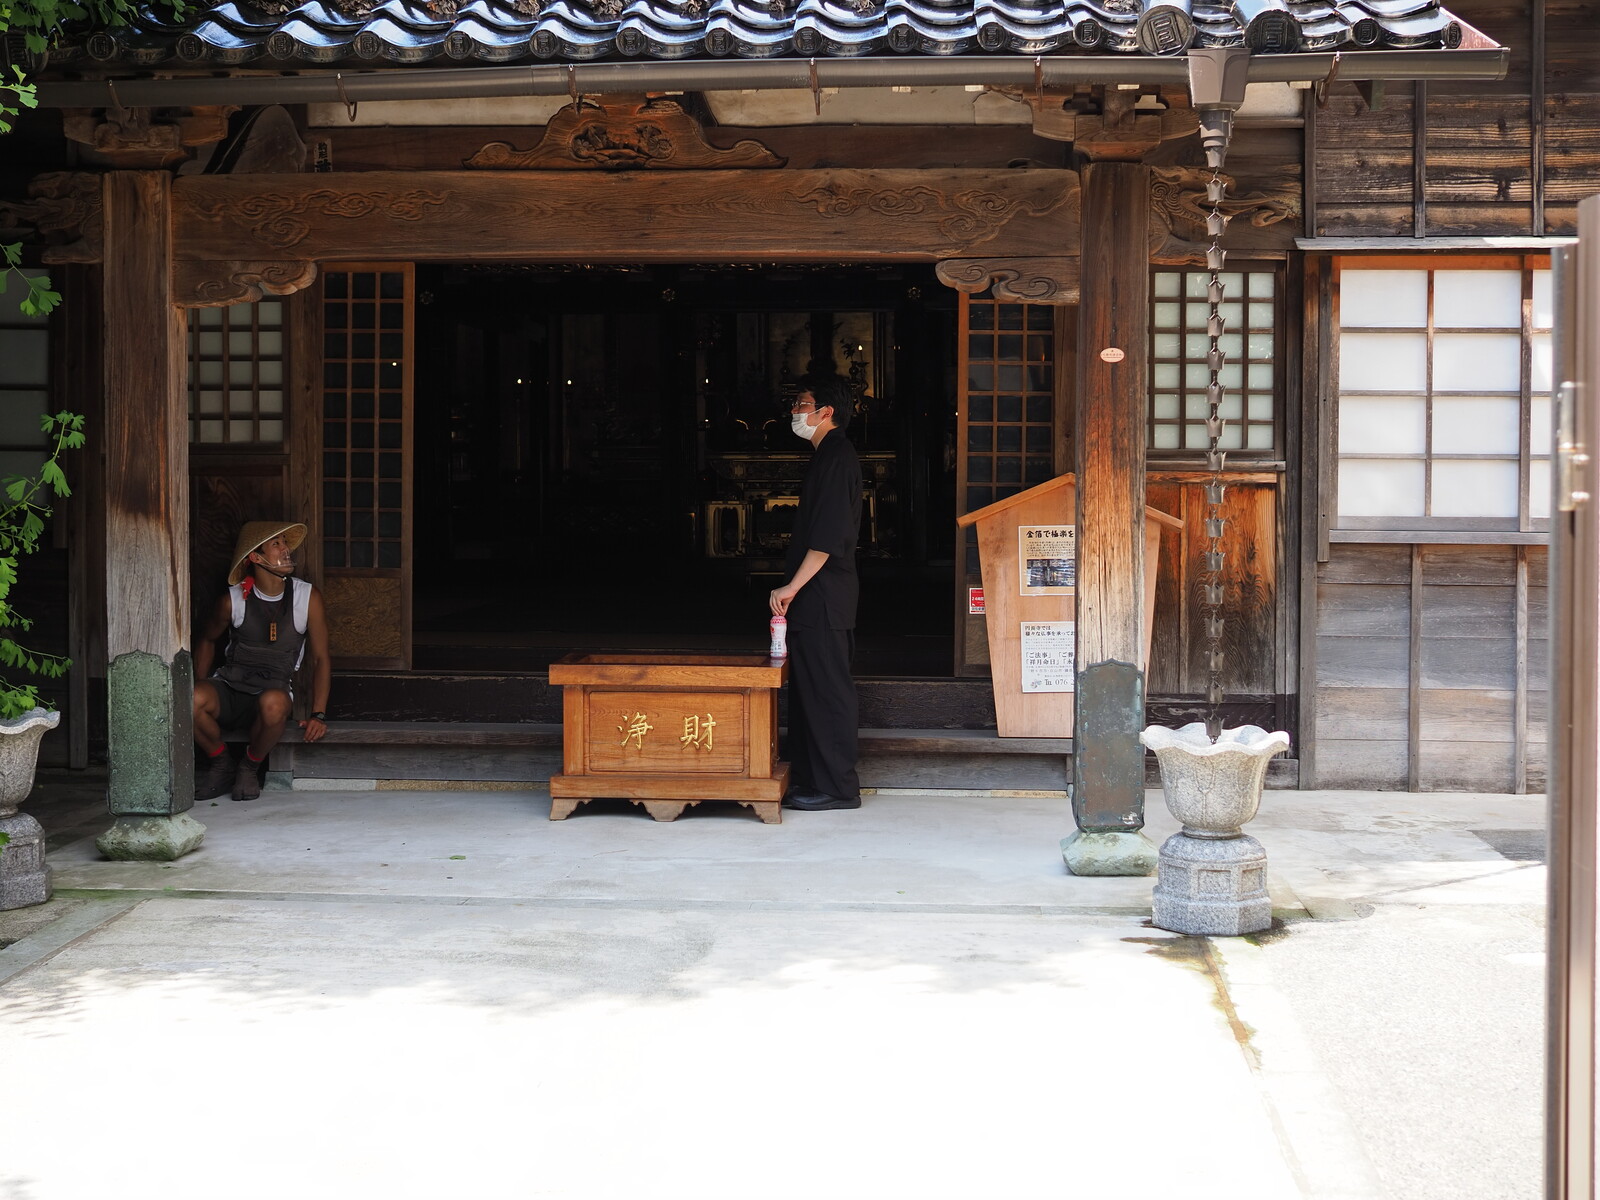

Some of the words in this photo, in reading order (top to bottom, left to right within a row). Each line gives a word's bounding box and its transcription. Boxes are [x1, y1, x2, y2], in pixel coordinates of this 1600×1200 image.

[1026, 529, 1074, 538] 金箔で極楽を
